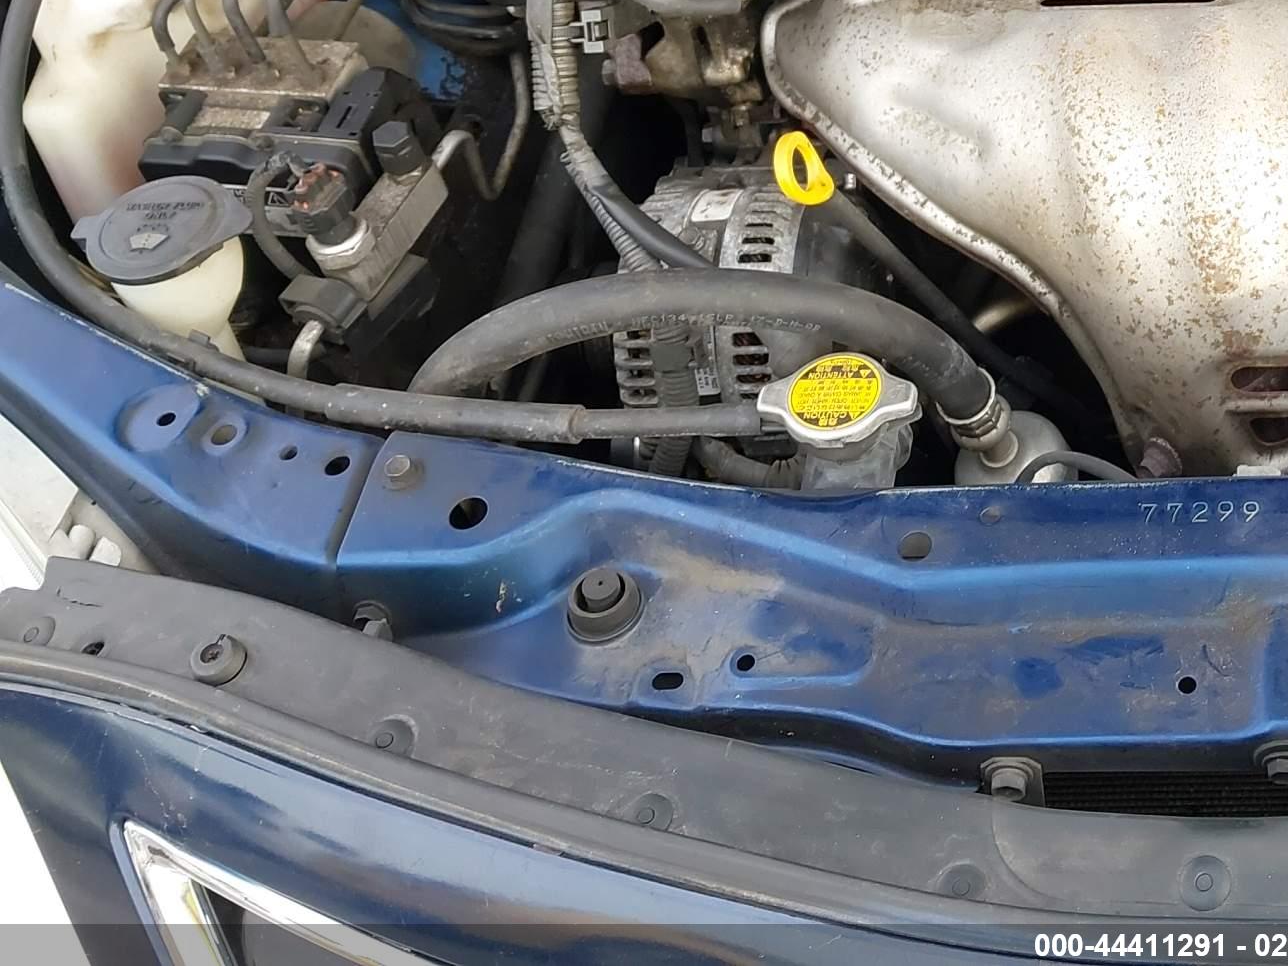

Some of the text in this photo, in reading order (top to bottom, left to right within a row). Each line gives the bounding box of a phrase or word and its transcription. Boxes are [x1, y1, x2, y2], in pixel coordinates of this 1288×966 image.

[808, 371, 854, 380] ATTENTION
[803, 411, 847, 420] CAUTION
[1138, 500, 1260, 524] 77299
